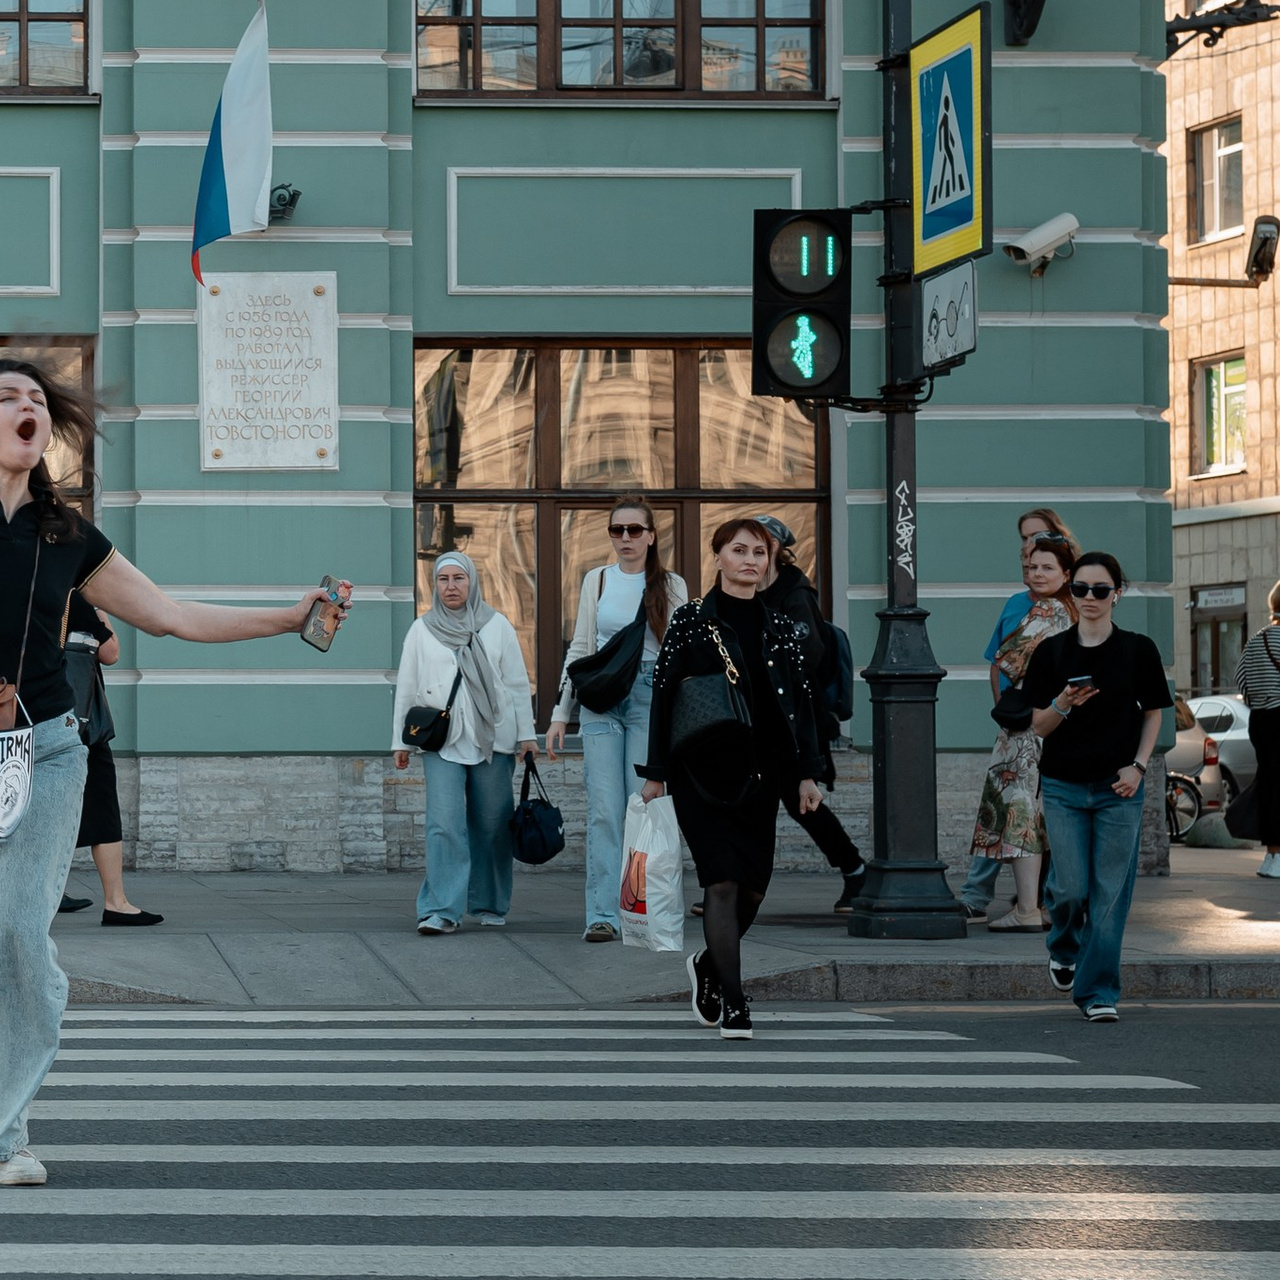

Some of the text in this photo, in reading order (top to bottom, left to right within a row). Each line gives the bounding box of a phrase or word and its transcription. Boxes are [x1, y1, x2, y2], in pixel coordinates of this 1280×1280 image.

[801, 236, 834, 277] 11
[245, 294, 291, 308] ЗДЕСЬ
[225, 310, 310, 324] С 1956 ГОДА
[225, 325, 312, 342] ПО 1989 ГОД
[236, 342, 301, 356] РАБОТАЛ
[215, 357, 322, 371] ВЫДАЮЩИЙСЯ
[230, 374, 309, 388] РЕЖИССЕР
[234, 389, 302, 404] ГЕОРГИЙ
[207, 407, 331, 422] АЛЕКСАНДРОВИЧ
[206, 424, 334, 441] ТОВСТОНОГОВ
